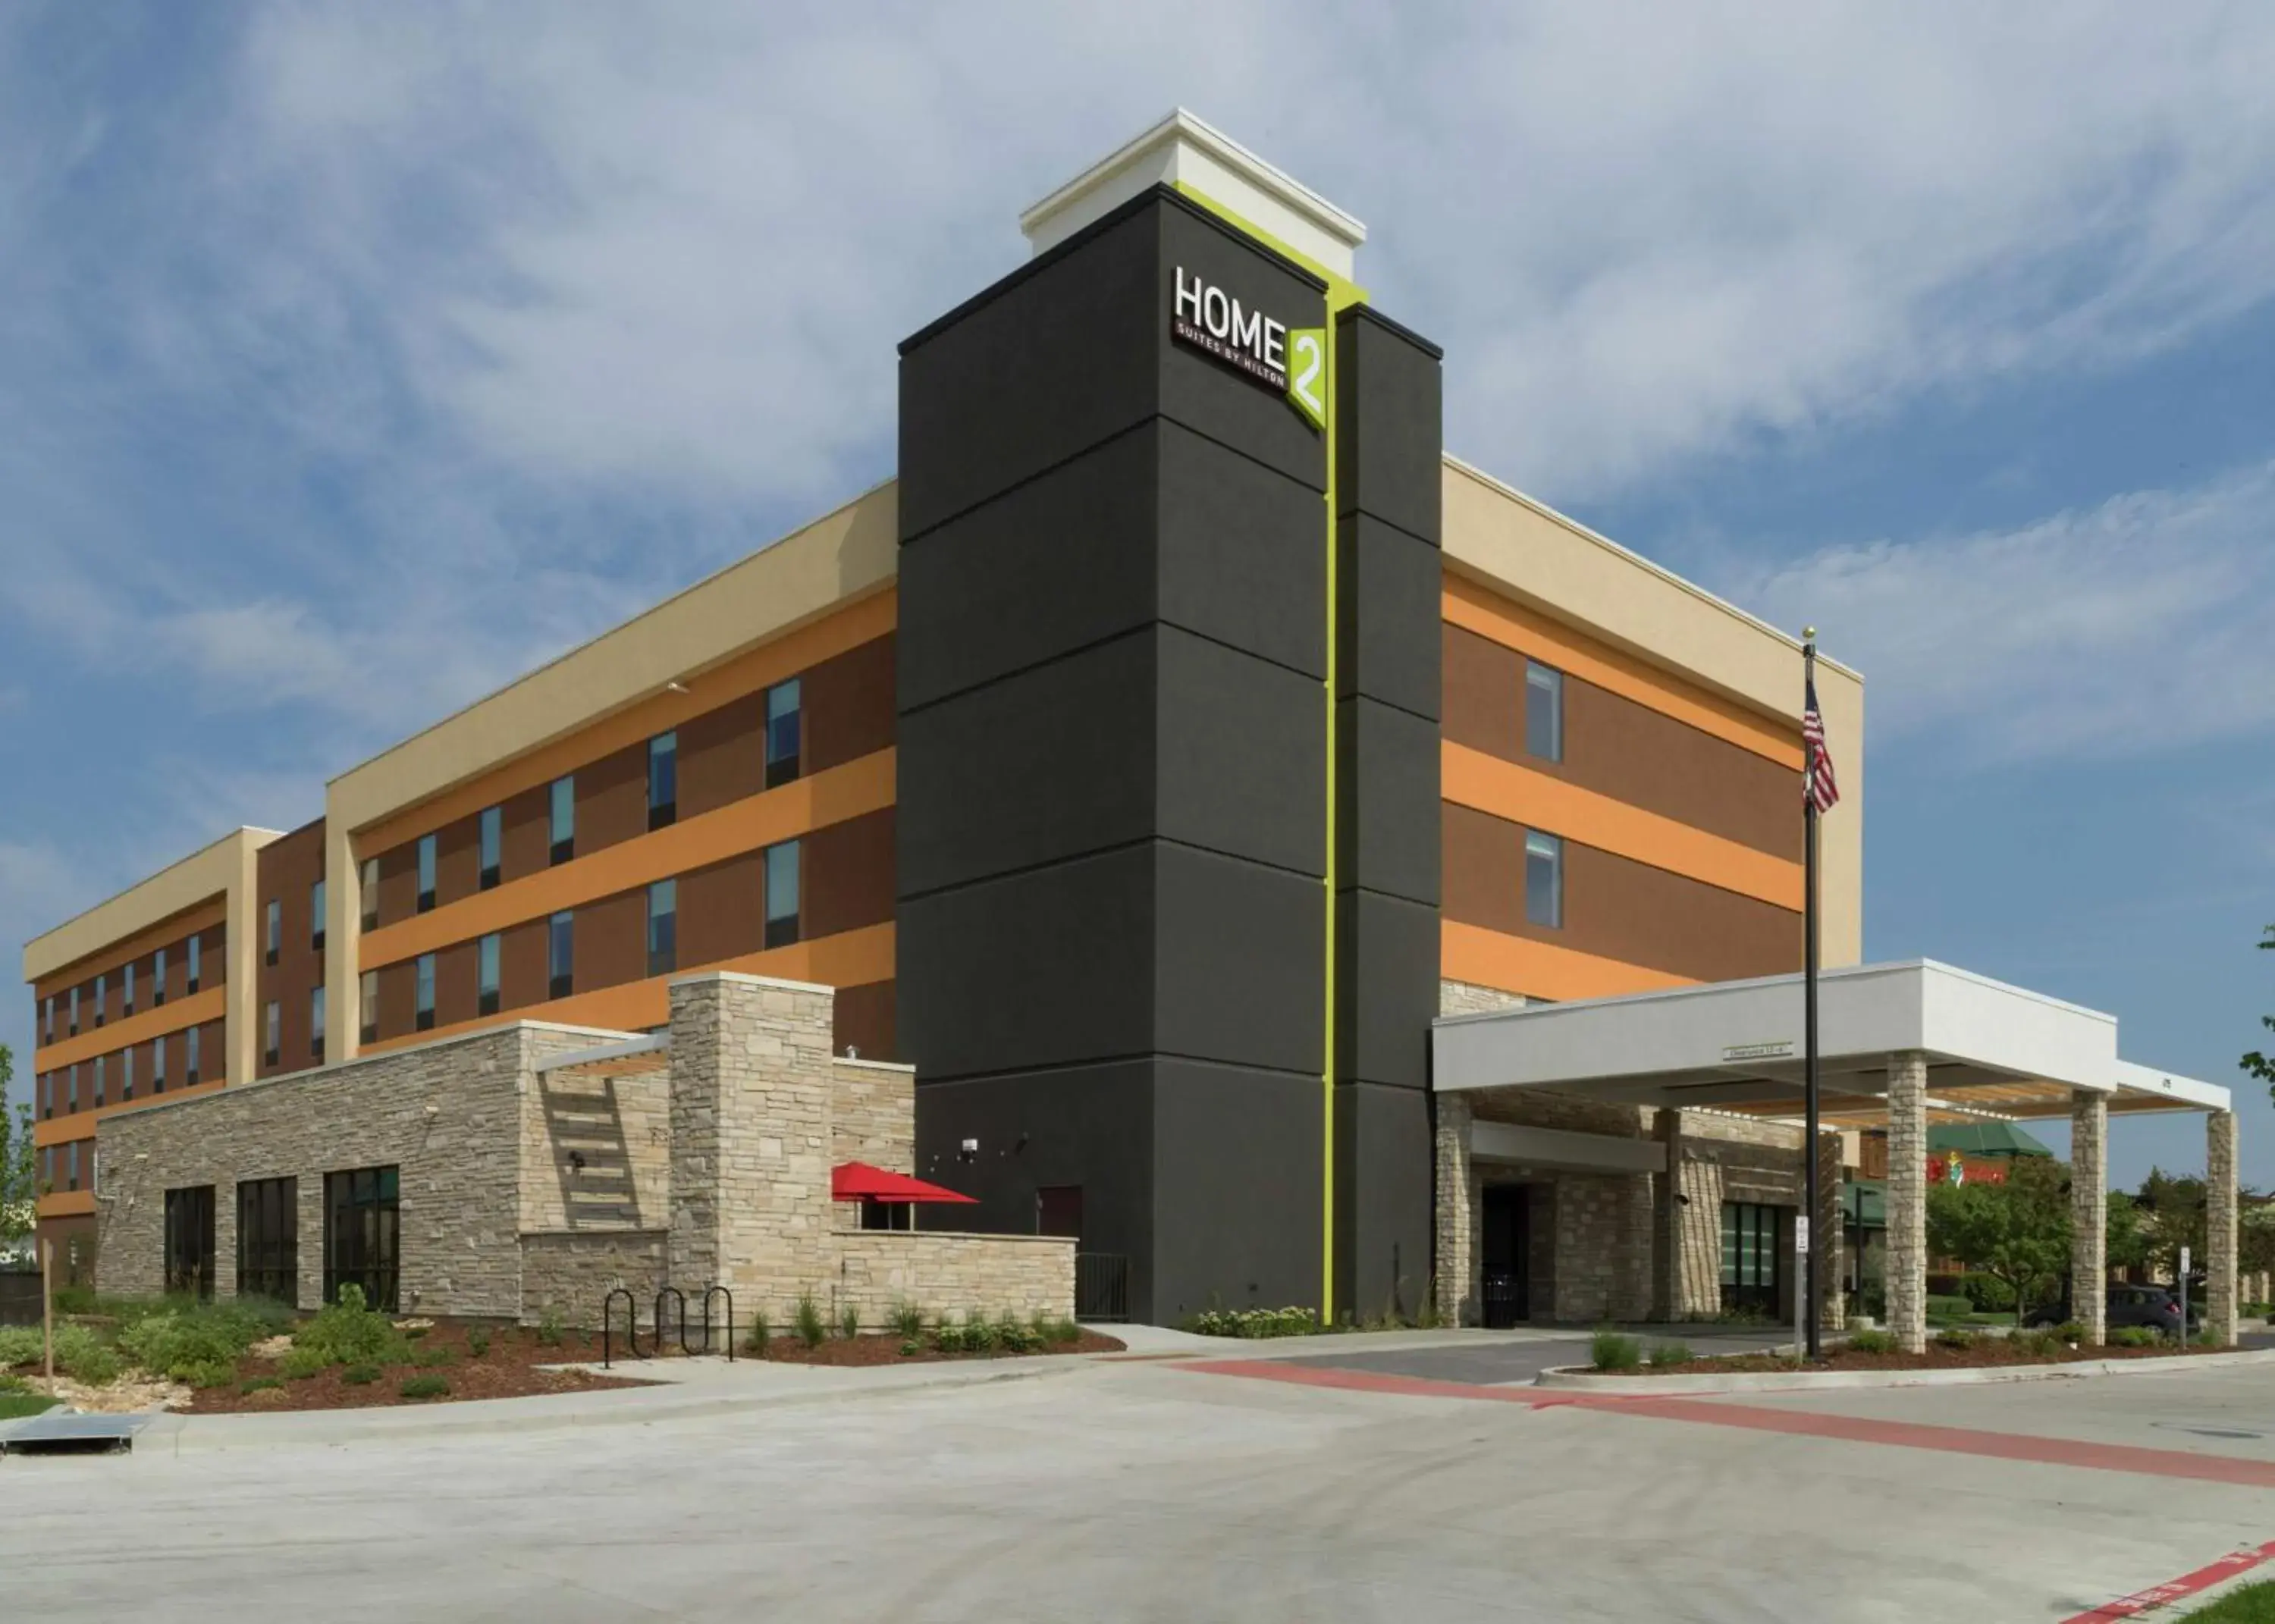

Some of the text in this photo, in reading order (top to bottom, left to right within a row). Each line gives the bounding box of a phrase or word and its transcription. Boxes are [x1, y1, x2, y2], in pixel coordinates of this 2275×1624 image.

[1175, 266, 1322, 415] HOME 2
[1178, 322, 1285, 387] SUITES BY HILTON
